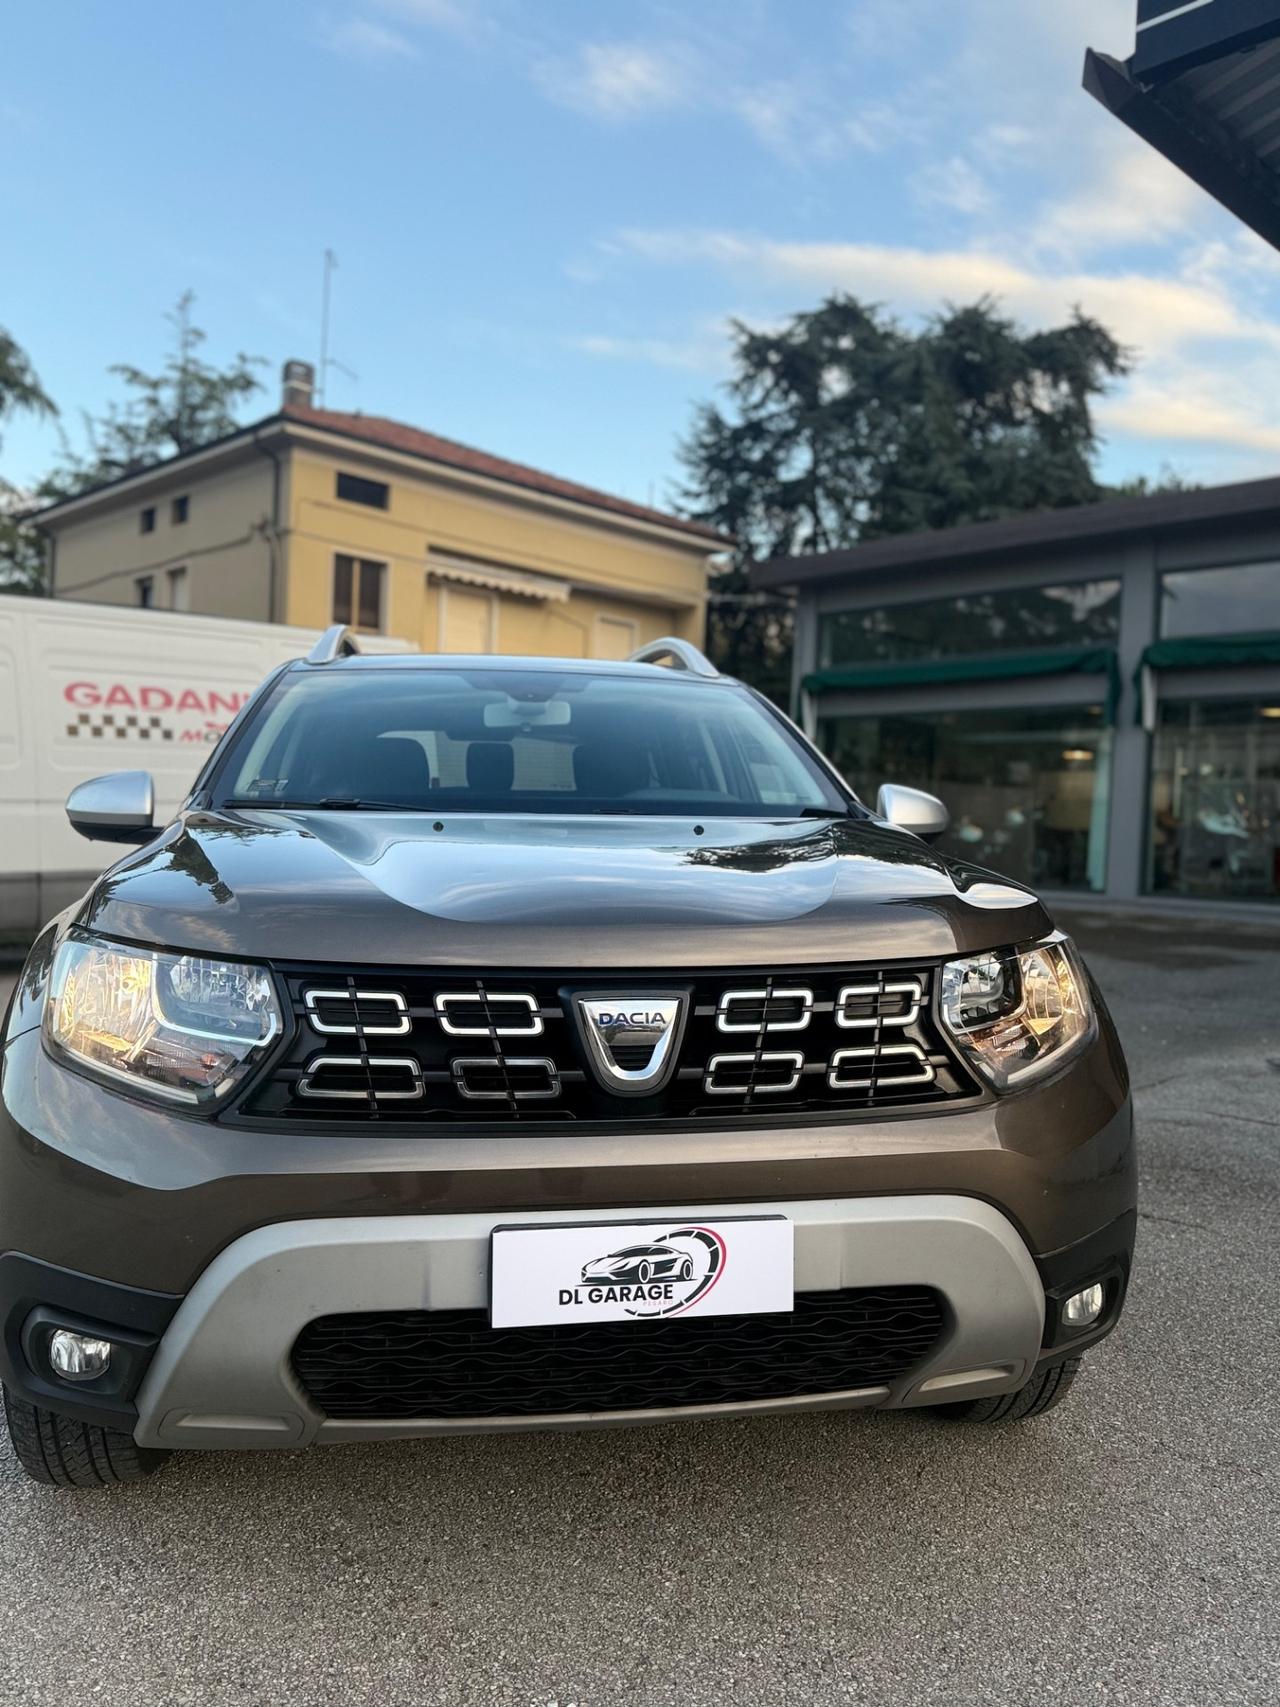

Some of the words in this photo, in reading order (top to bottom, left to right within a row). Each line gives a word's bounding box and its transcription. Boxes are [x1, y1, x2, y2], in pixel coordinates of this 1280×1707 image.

[63, 681, 250, 716] GADAN
[599, 1012, 666, 1025] DACIA
[559, 1289, 583, 1306] DL
[588, 1284, 673, 1304] GARAGE
